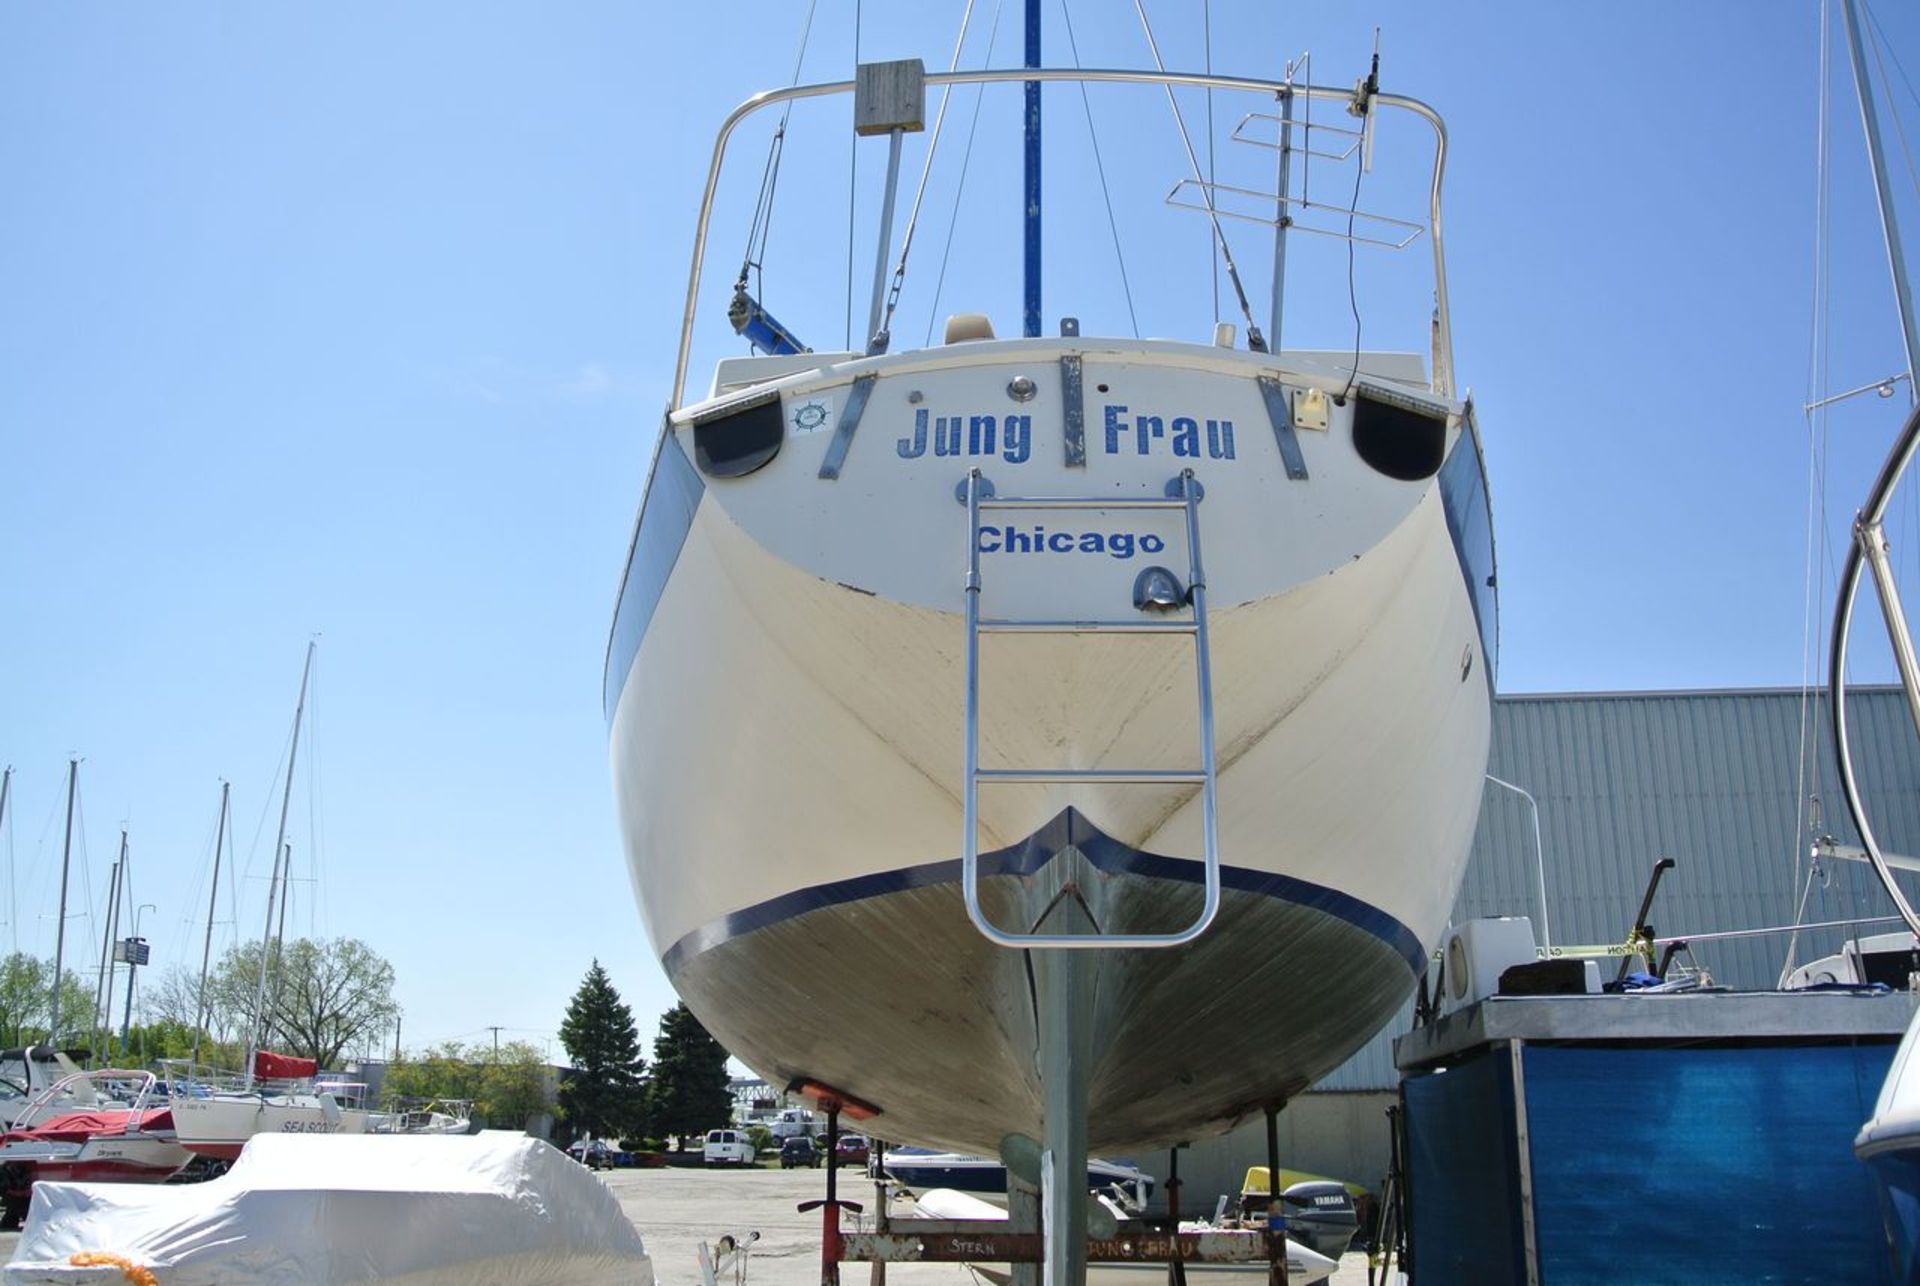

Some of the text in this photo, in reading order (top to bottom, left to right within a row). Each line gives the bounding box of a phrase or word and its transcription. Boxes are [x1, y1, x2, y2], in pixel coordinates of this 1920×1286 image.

[896, 404, 1236, 464] Jung Frau
[976, 526, 1165, 559] Chicago
[1314, 1195, 1345, 1206] YAMAHA
